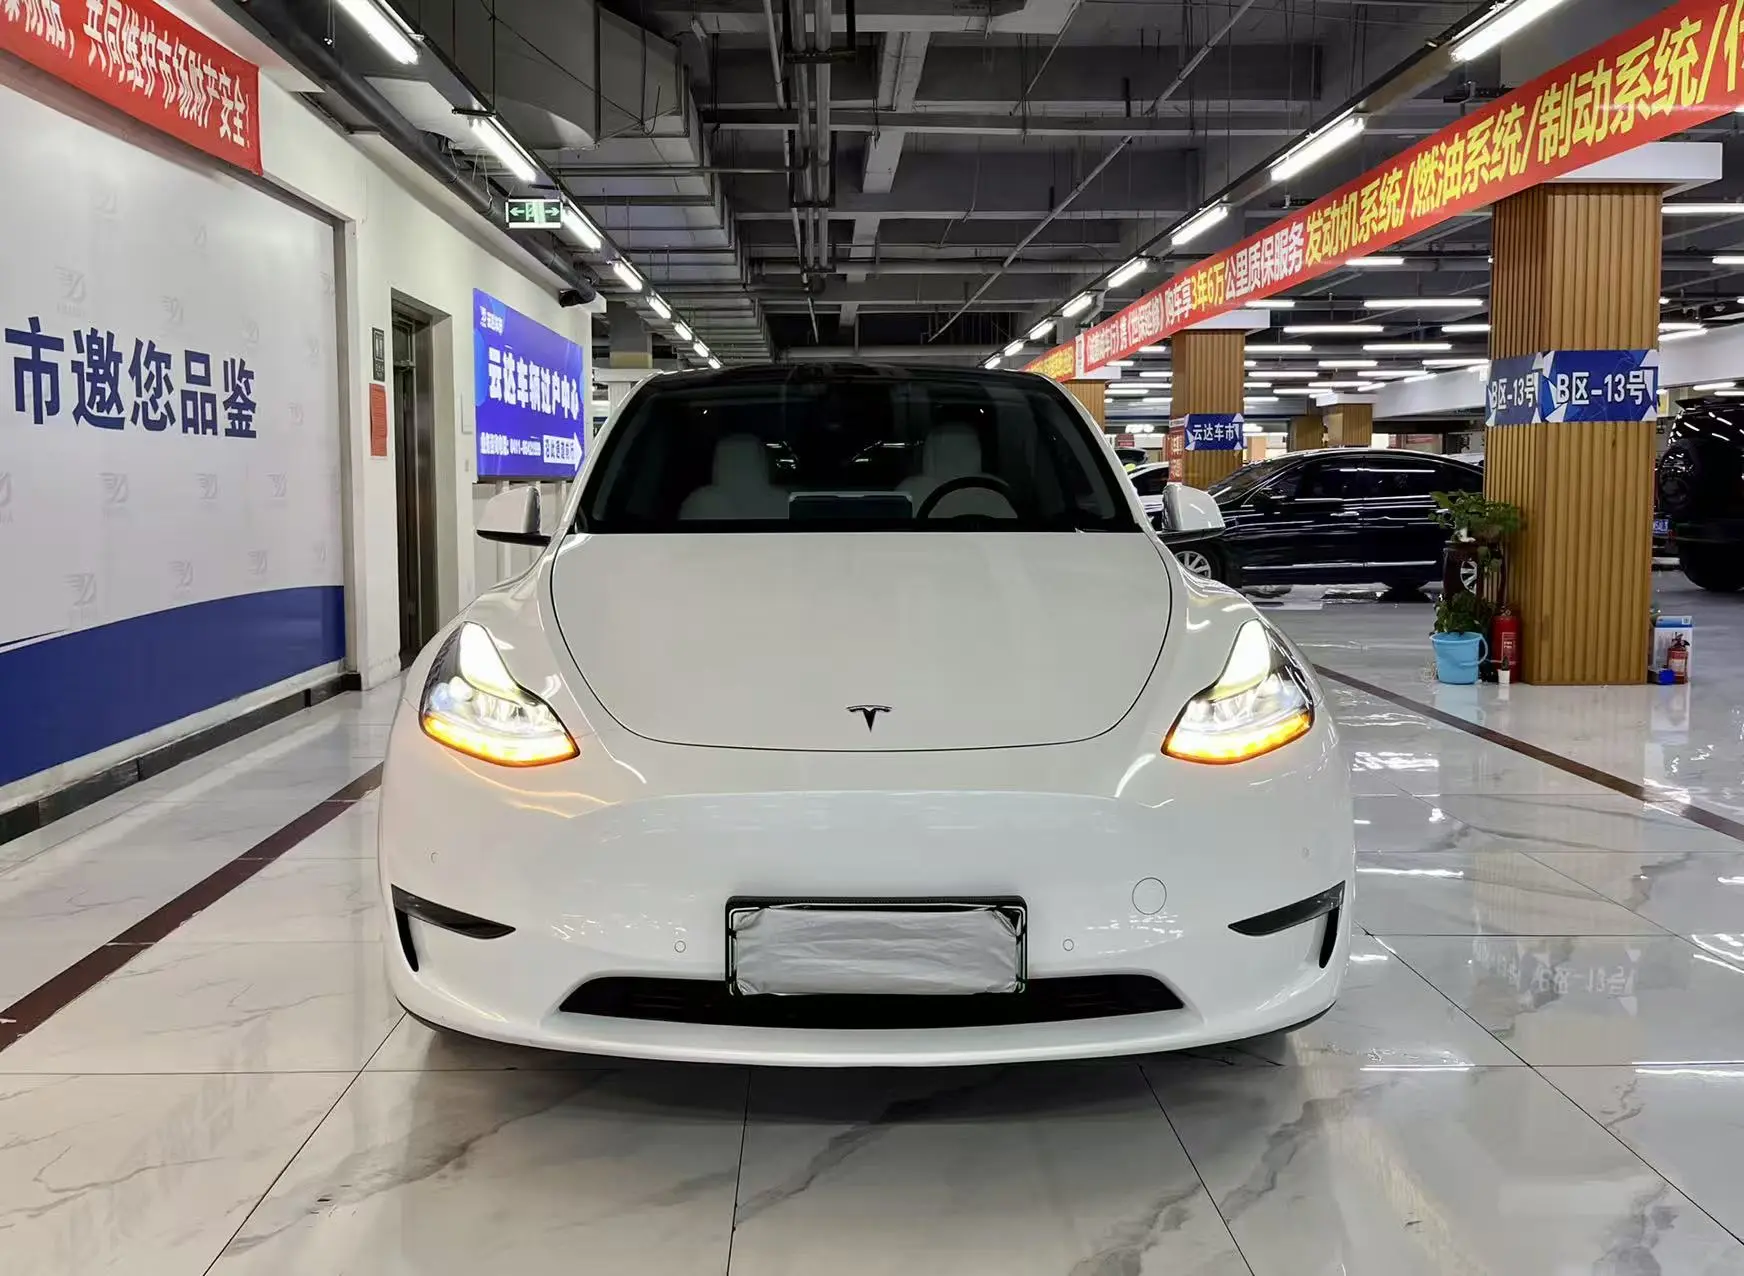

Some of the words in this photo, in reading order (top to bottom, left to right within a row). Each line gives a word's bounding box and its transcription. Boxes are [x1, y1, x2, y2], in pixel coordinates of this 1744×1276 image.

[0, 0, 250, 149] 品，共同维护市场财产安全！
[4, 316, 257, 439] 市邀您品鉴
[1491, 370, 1536, 410] B区-13号
[1556, 370, 1646, 406] B区-13号
[1192, 423, 1236, 442] 云达车市
